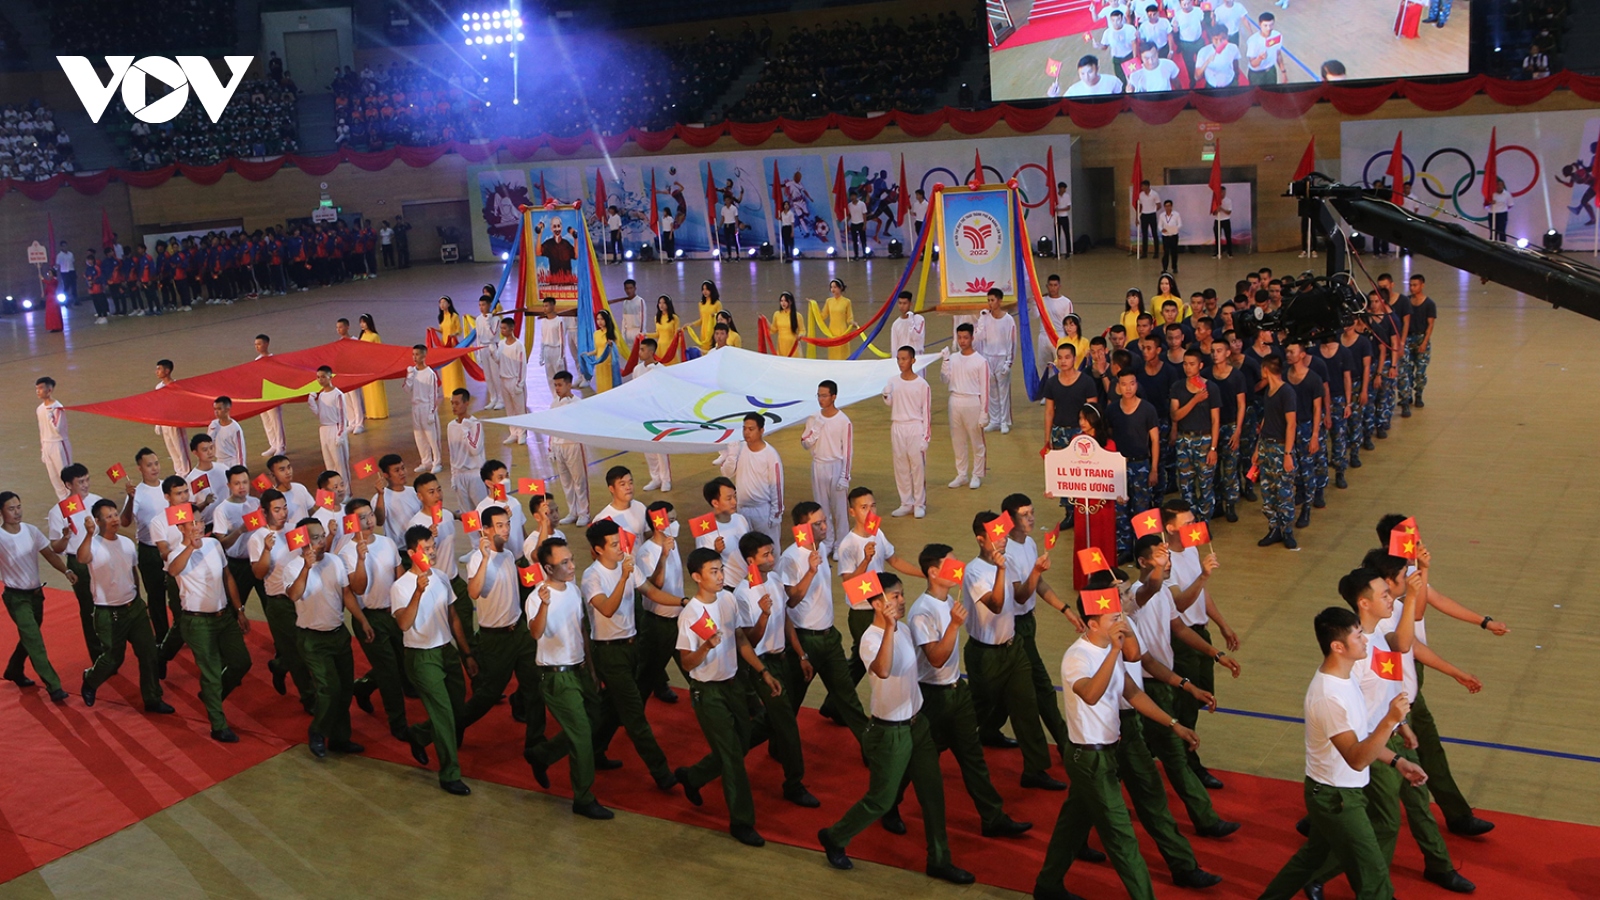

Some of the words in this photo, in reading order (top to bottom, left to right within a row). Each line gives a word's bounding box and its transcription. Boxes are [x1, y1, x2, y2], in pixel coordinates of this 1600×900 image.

[1057, 467, 1067, 476] LL
[1069, 466, 1081, 477] VŨ
[1084, 468, 1114, 478] TRANG
[1057, 481, 1087, 491] TRUNG
[1089, 482, 1115, 493] ƯƠNG
